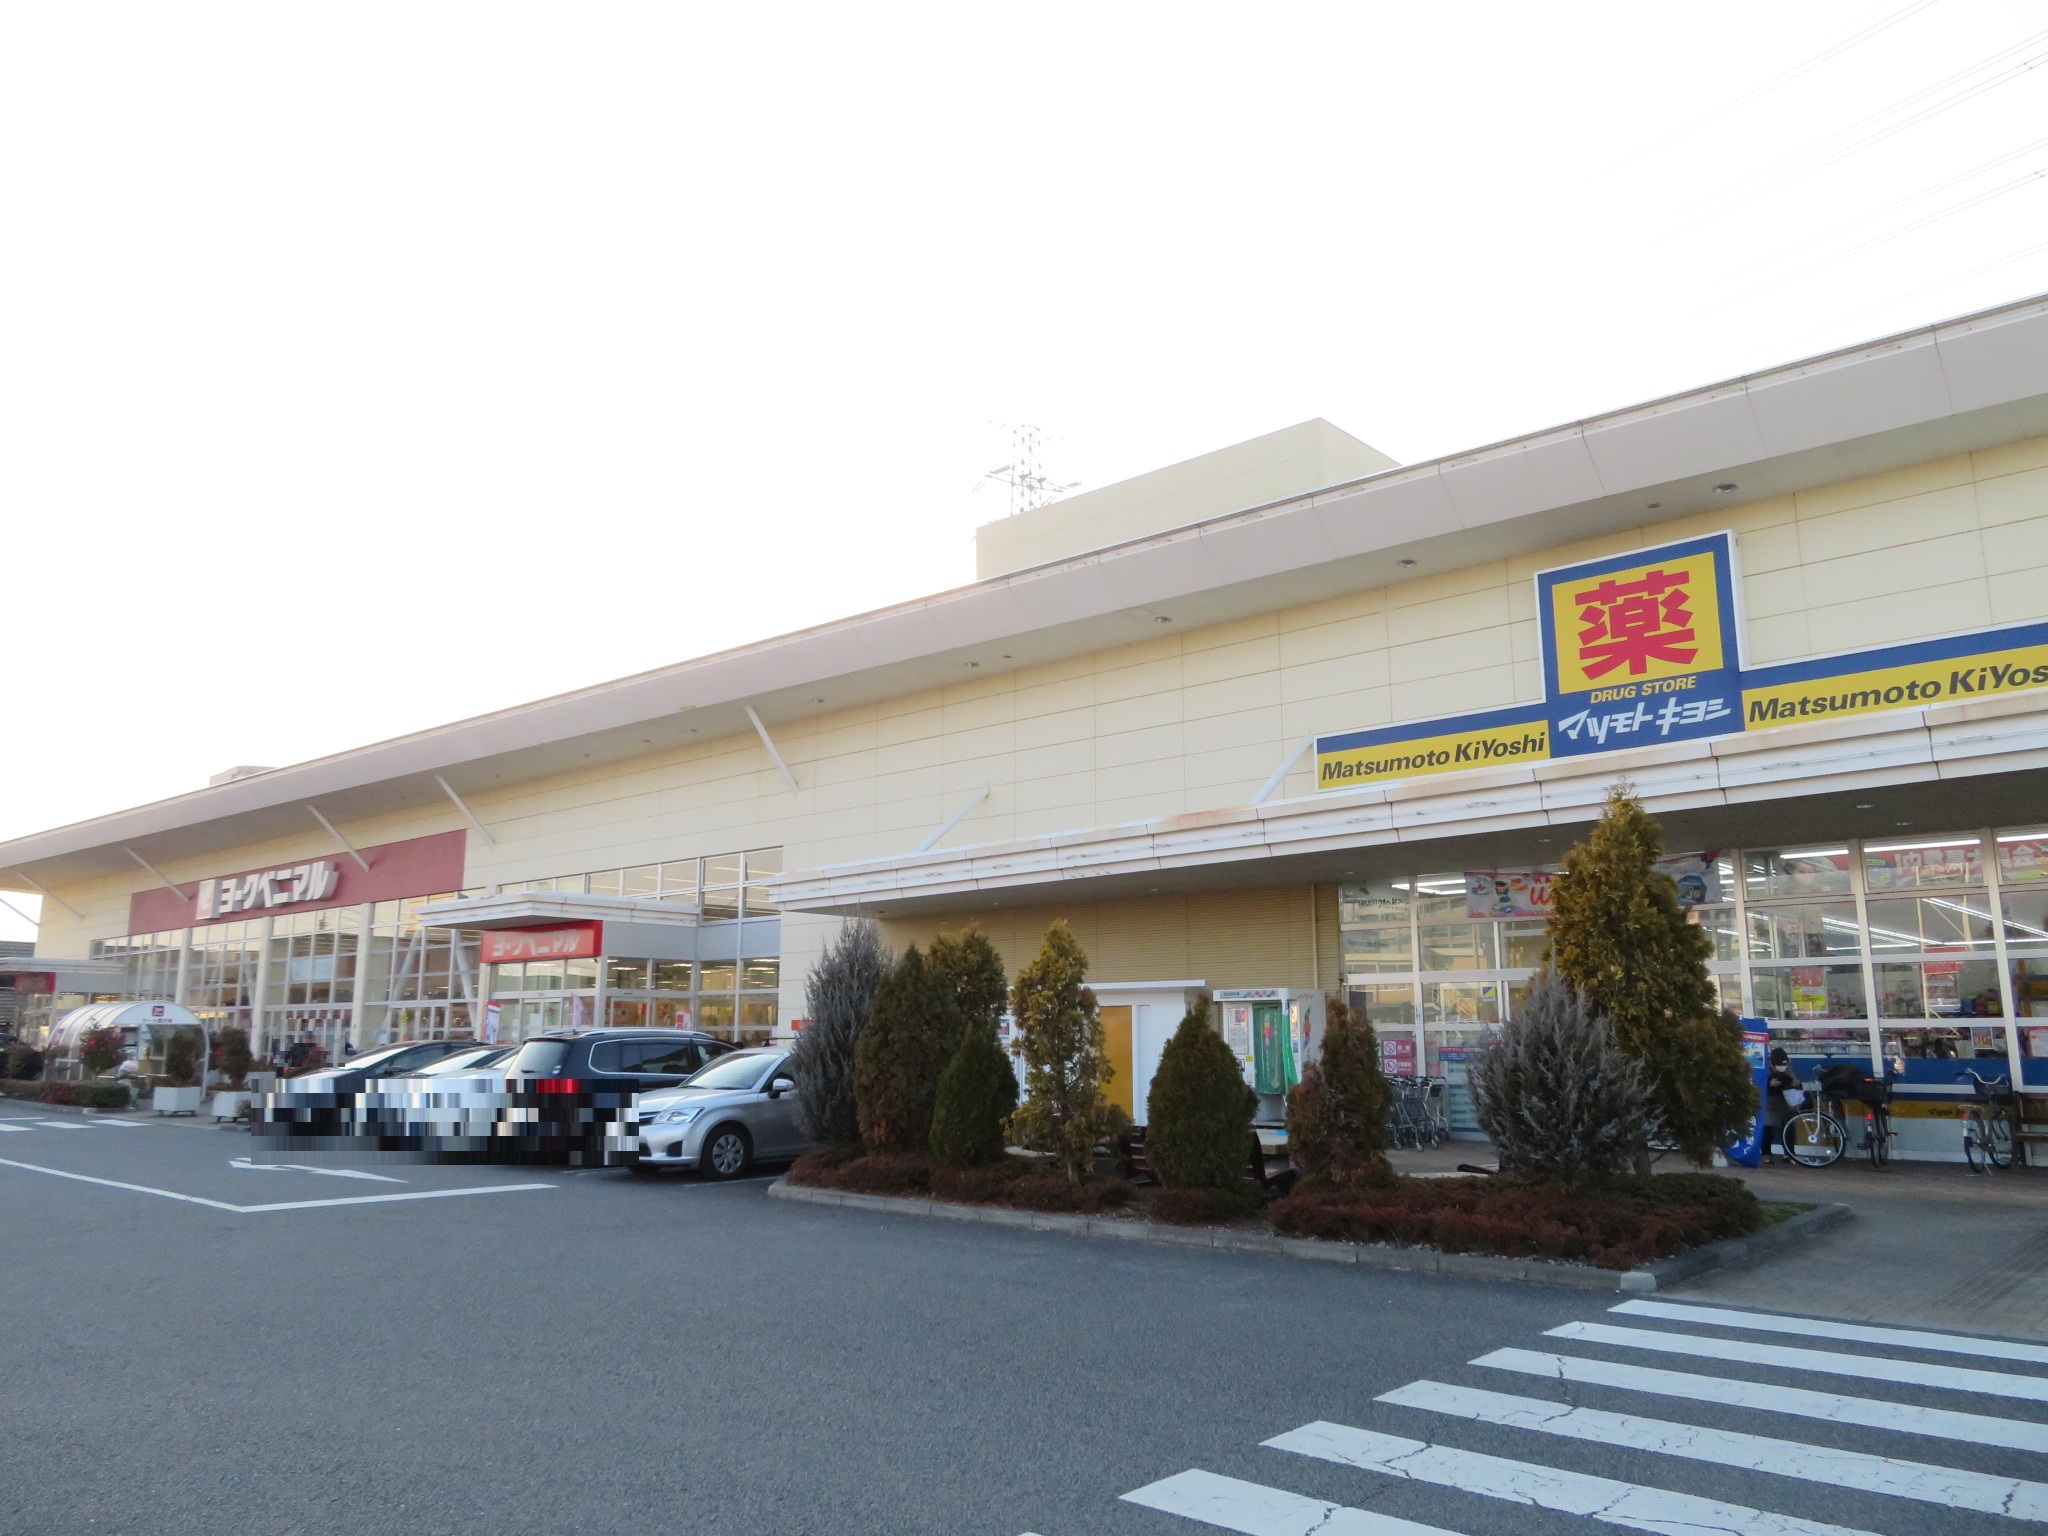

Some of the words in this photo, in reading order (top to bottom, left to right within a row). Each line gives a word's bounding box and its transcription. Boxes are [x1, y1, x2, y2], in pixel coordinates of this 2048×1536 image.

[1574, 569, 1699, 681] 薬
[1590, 685, 1637, 705] DRUG
[1641, 675, 1697, 697] STORE
[1749, 679, 1942, 723] Matsumoto
[1558, 696, 1732, 745] マツモトキヨシ
[1321, 748, 1451, 781] Matsumoto
[1454, 731, 1546, 763] KiYoshi
[218, 861, 334, 914] ヨークベニマル
